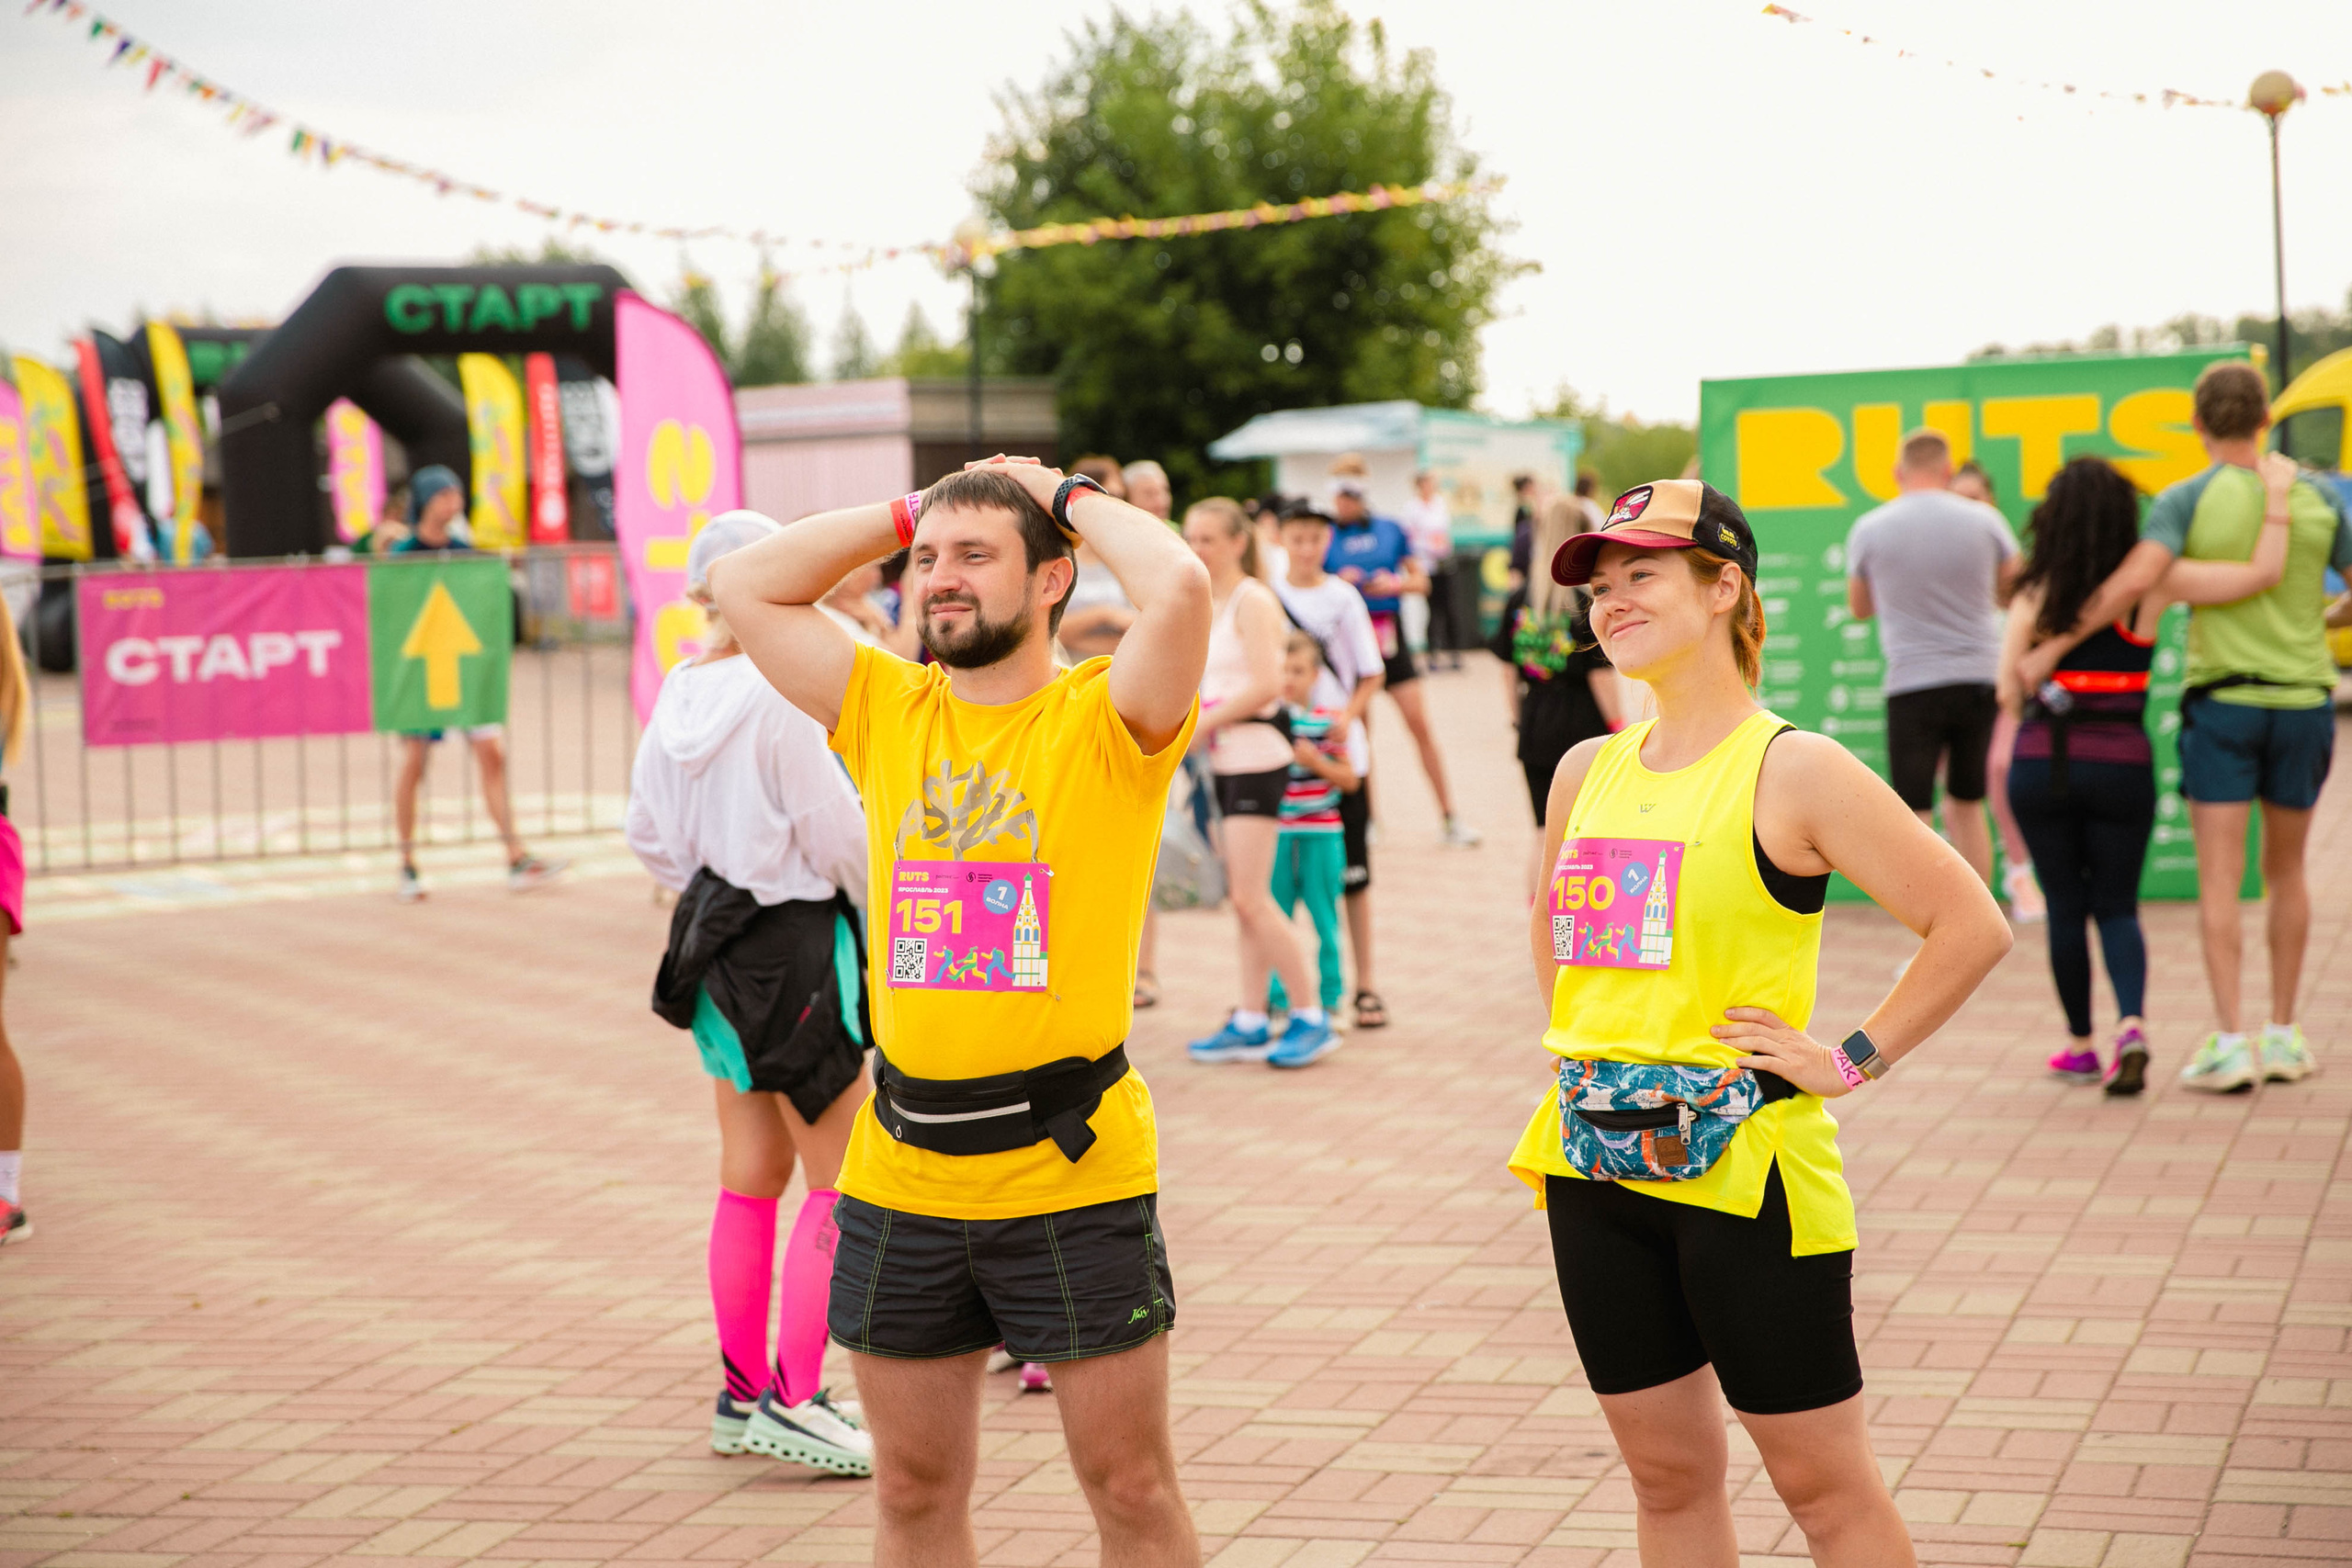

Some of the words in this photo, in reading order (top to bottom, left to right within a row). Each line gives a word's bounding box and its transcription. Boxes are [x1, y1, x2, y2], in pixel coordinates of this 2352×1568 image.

[384, 282, 603, 332] СТАРТ
[1736, 389, 2207, 511] RUTS
[106, 630, 342, 686] СТАРТ
[899, 872, 930, 882] RUTS
[1627, 868, 1639, 882] 1
[1629, 875, 1648, 894] ВОЛНА
[986, 897, 1009, 909] ВОЛНА
[997, 886, 1008, 900] 1
[1554, 875, 1615, 910] 150
[896, 898, 963, 934] 151
